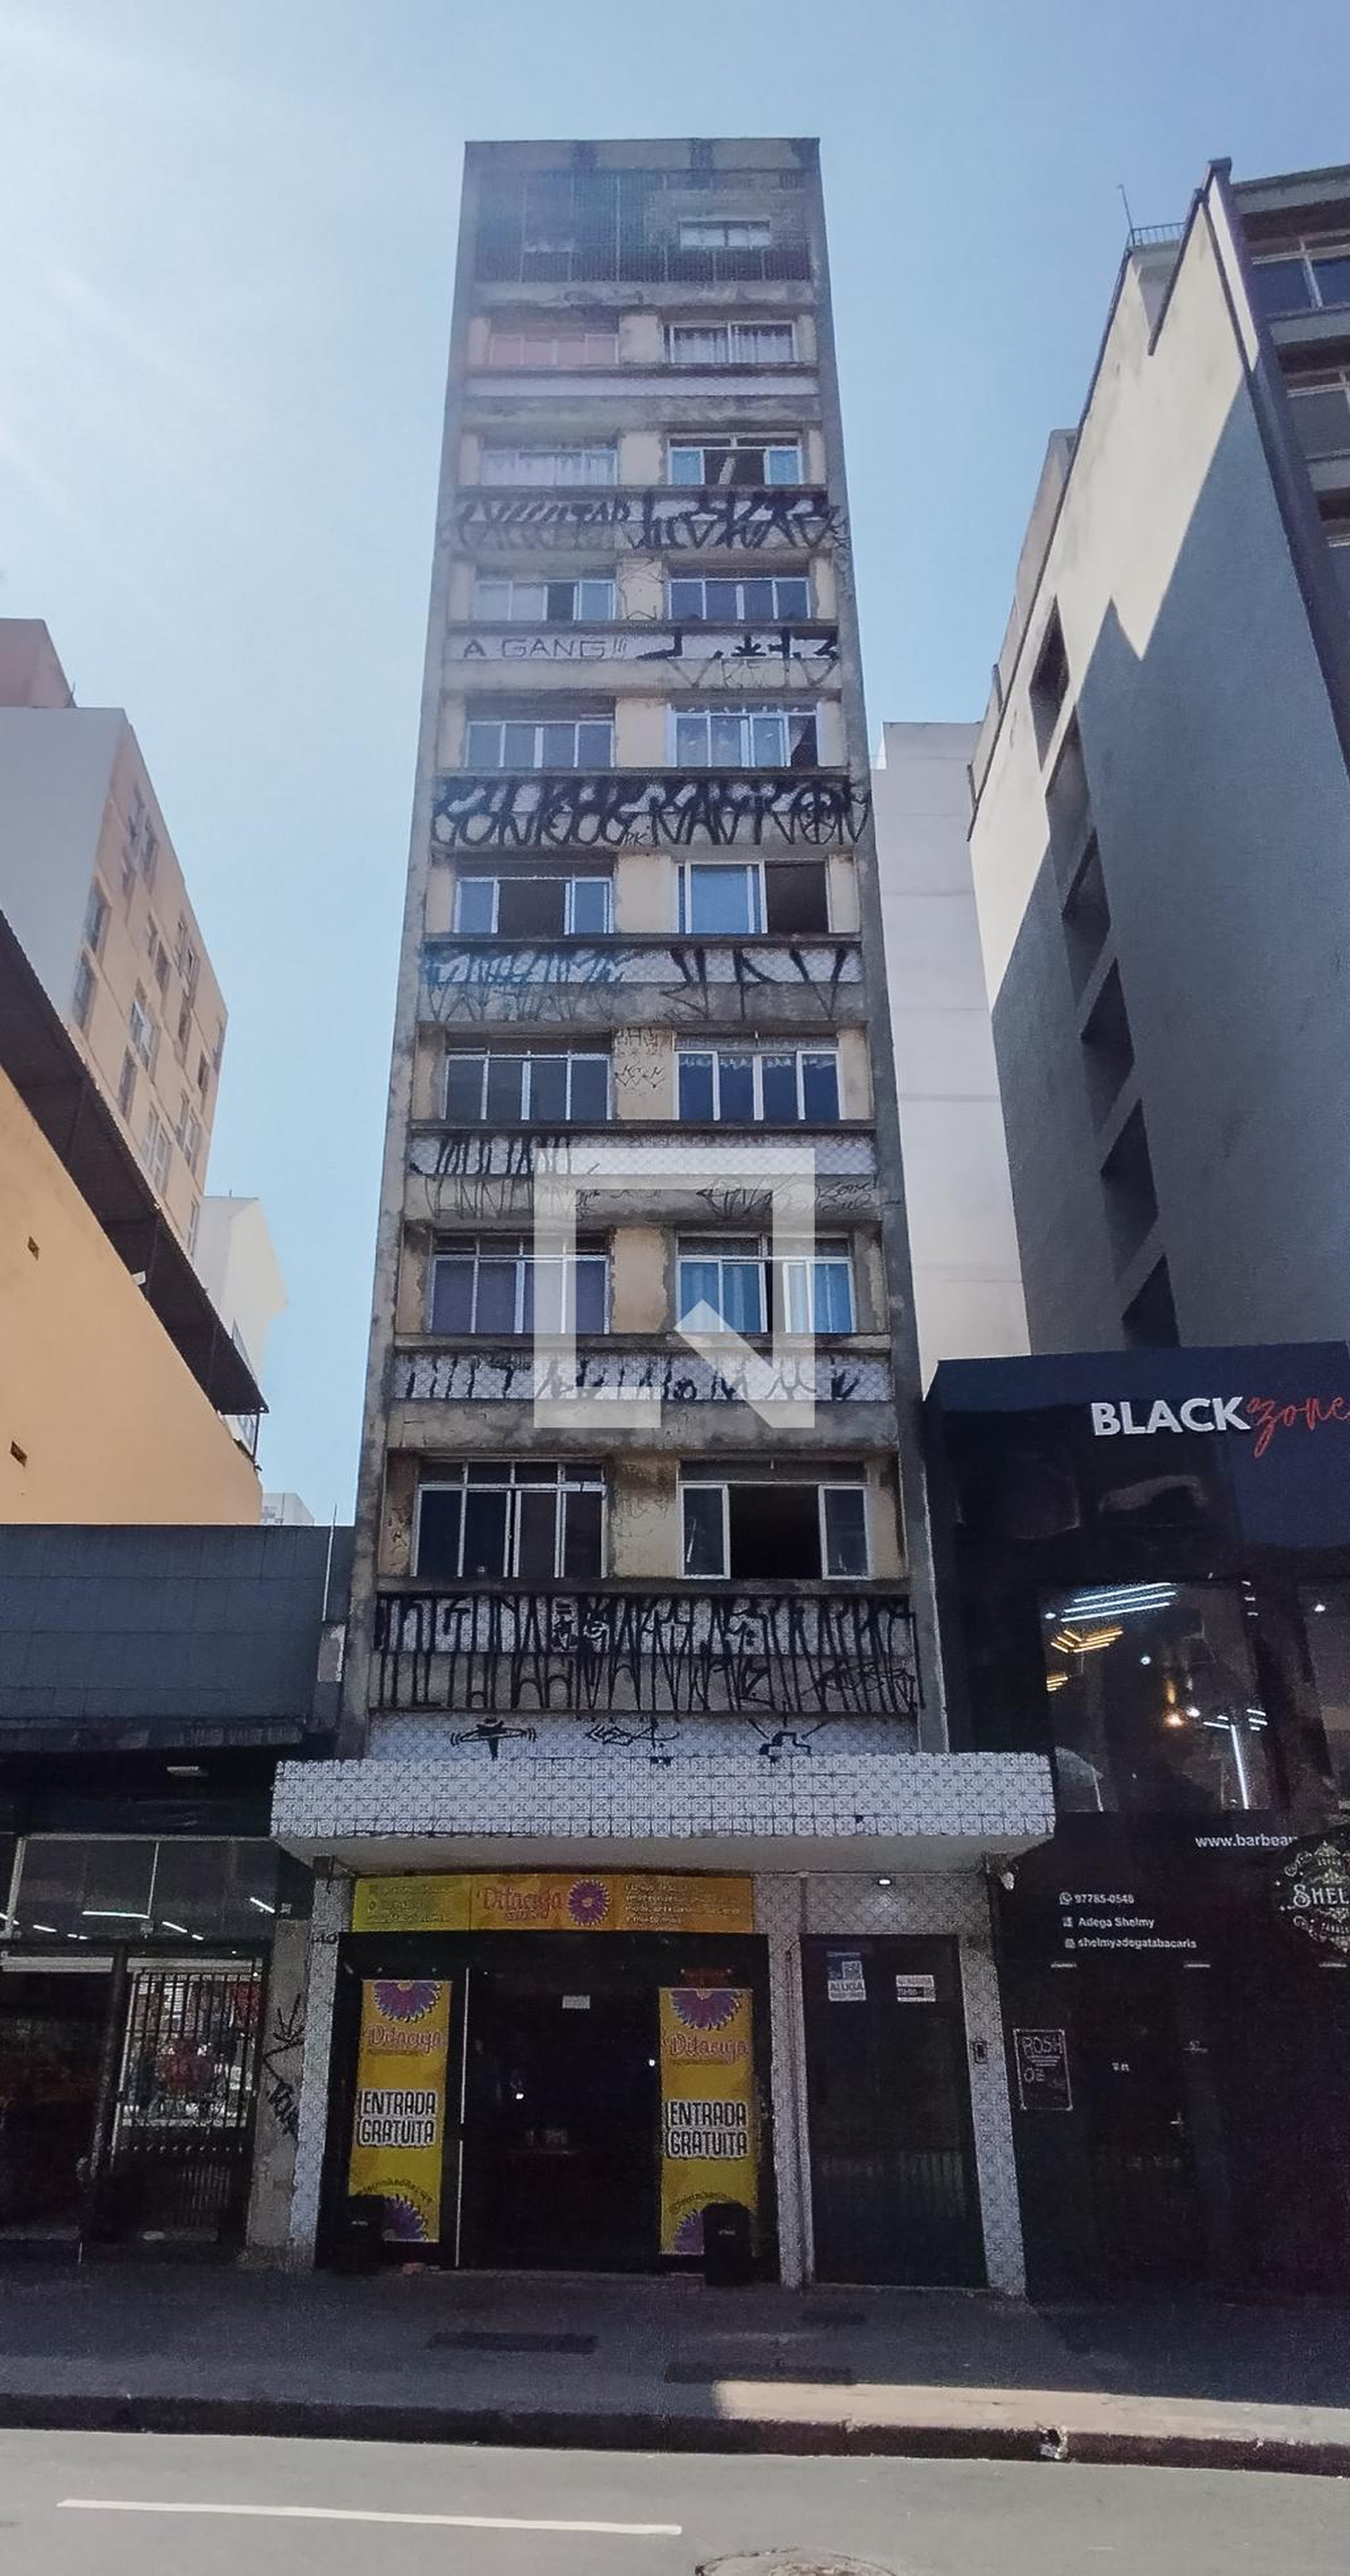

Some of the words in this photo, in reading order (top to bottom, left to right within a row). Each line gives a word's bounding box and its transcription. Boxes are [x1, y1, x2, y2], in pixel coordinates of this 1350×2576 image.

[1091, 1396, 1251, 1436] BLACK
[1078, 1917, 1112, 1929] Adega
[1114, 1917, 1155, 1929] Shelmy
[364, 2091, 436, 2115] ENTRADA
[670, 2101, 747, 2127] ENTRADA
[361, 2119, 435, 2144] GRATUITA
[671, 2131, 747, 2156] GRATUITA
